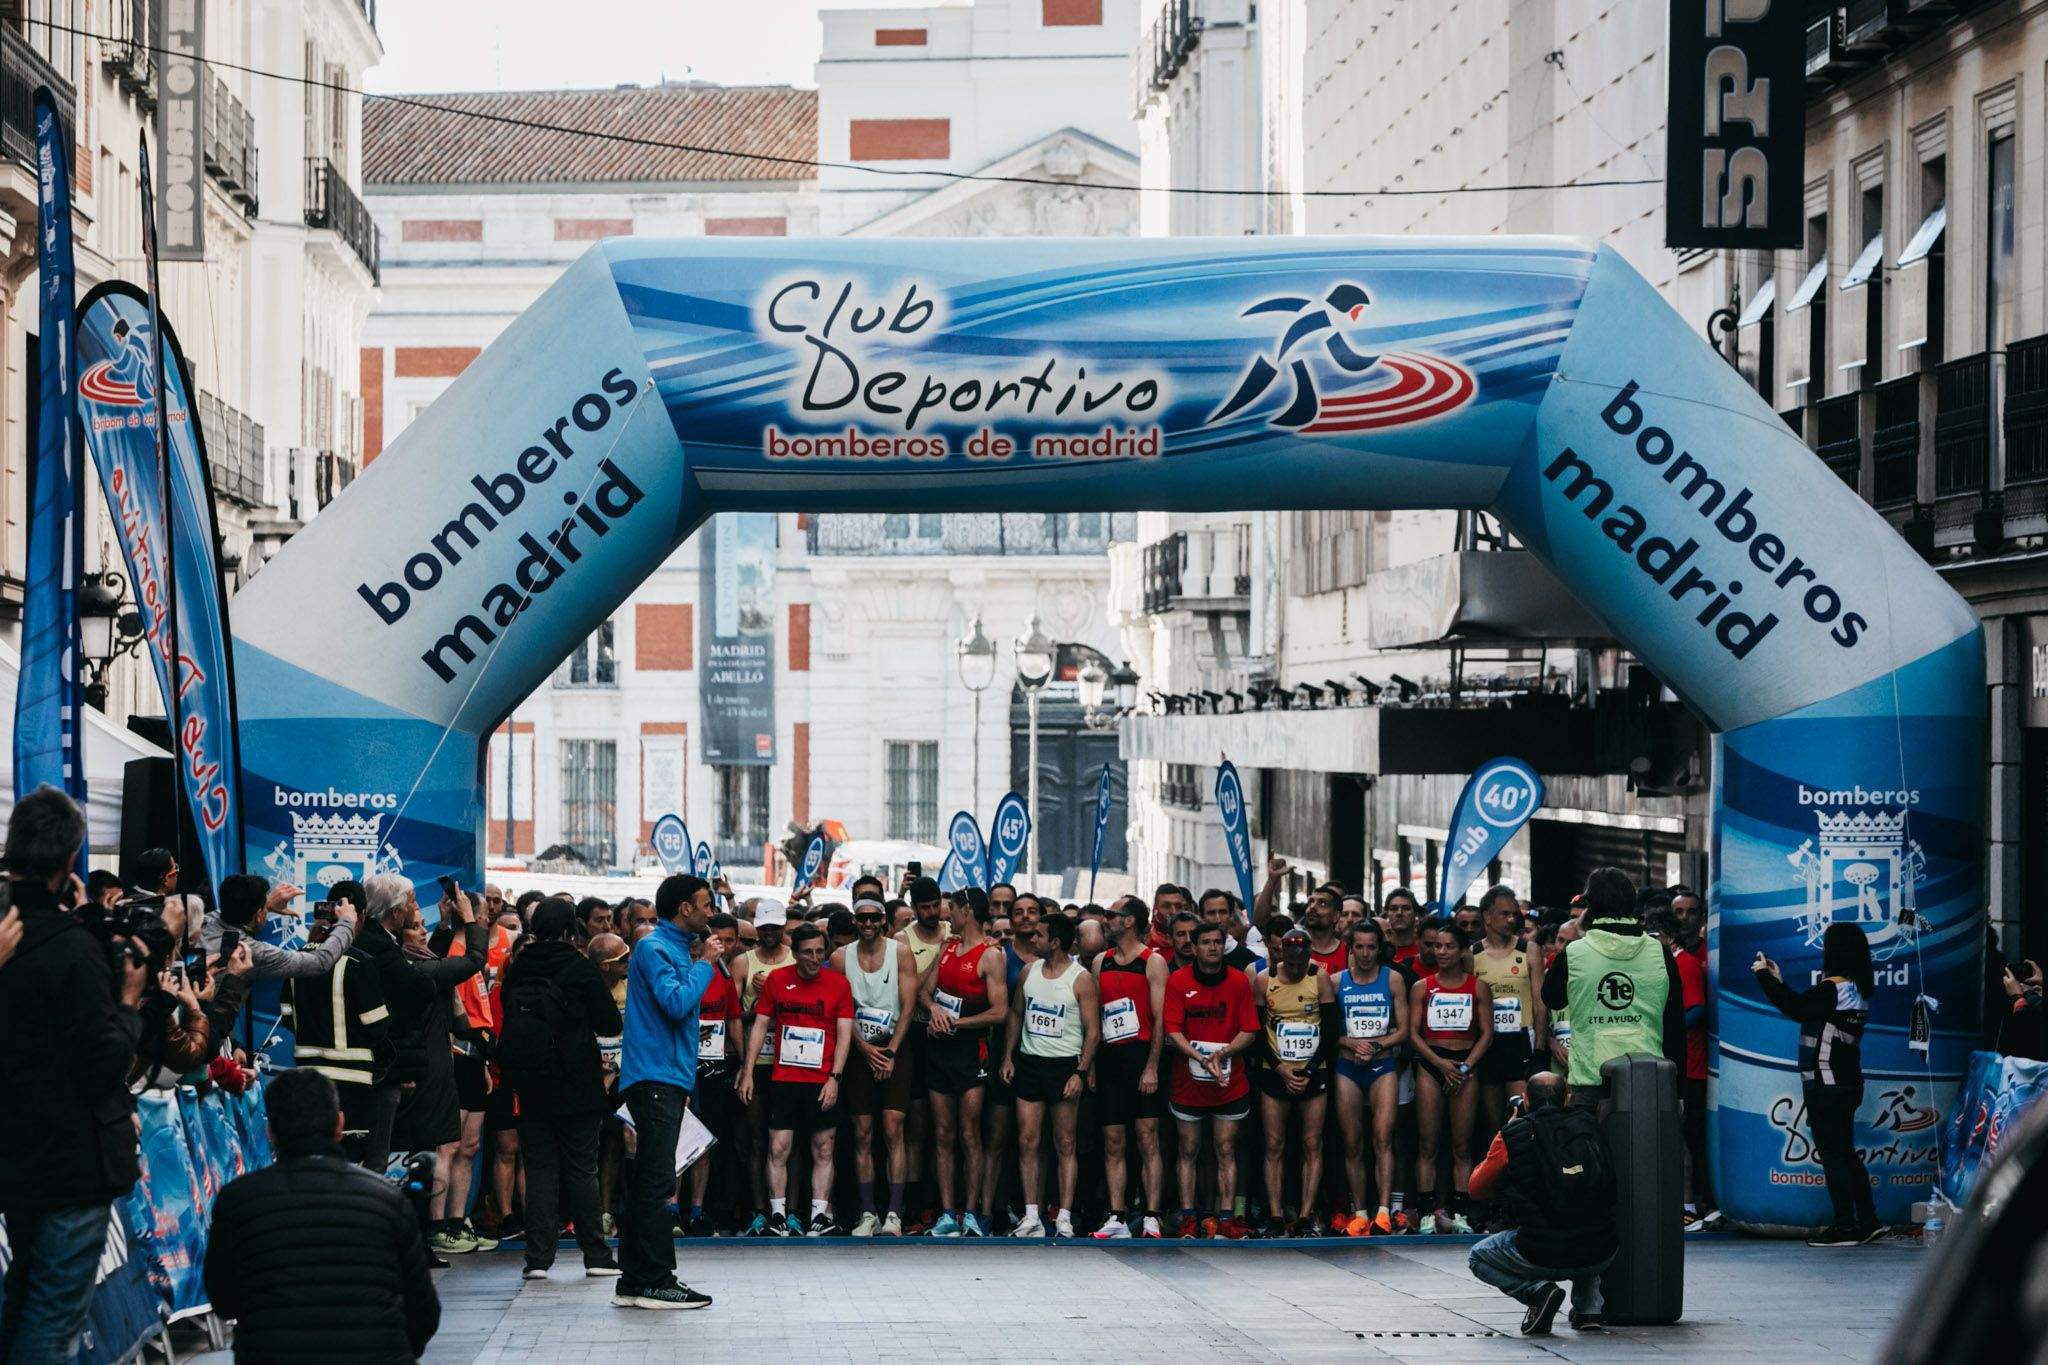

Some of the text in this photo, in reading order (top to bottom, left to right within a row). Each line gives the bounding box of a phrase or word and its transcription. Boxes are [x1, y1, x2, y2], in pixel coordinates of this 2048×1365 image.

[166, 99, 195, 247] HOUSE
[769, 280, 934, 338] Club
[801, 334, 1159, 431] Deportivo
[768, 428, 1160, 458] bomberos de madrid
[356, 366, 638, 627] bomberos
[1600, 379, 1868, 649] bomberos
[1543, 447, 1780, 661] madrid
[421, 458, 646, 685] madrid
[710, 644, 767, 658] MADRID
[275, 785, 397, 808] bomberos
[1798, 785, 1920, 806] bomberos
[1453, 825, 1489, 868] sub
[1031, 1014, 1057, 1028] 1661
[1112, 1016, 1125, 1029] 32
[1436, 1008, 1465, 1019] 1347
[860, 1022, 883, 1036] 1356
[1353, 1020, 1382, 1031] 1599
[798, 1043, 805, 1055] 1
[1285, 1038, 1313, 1050] 1195
